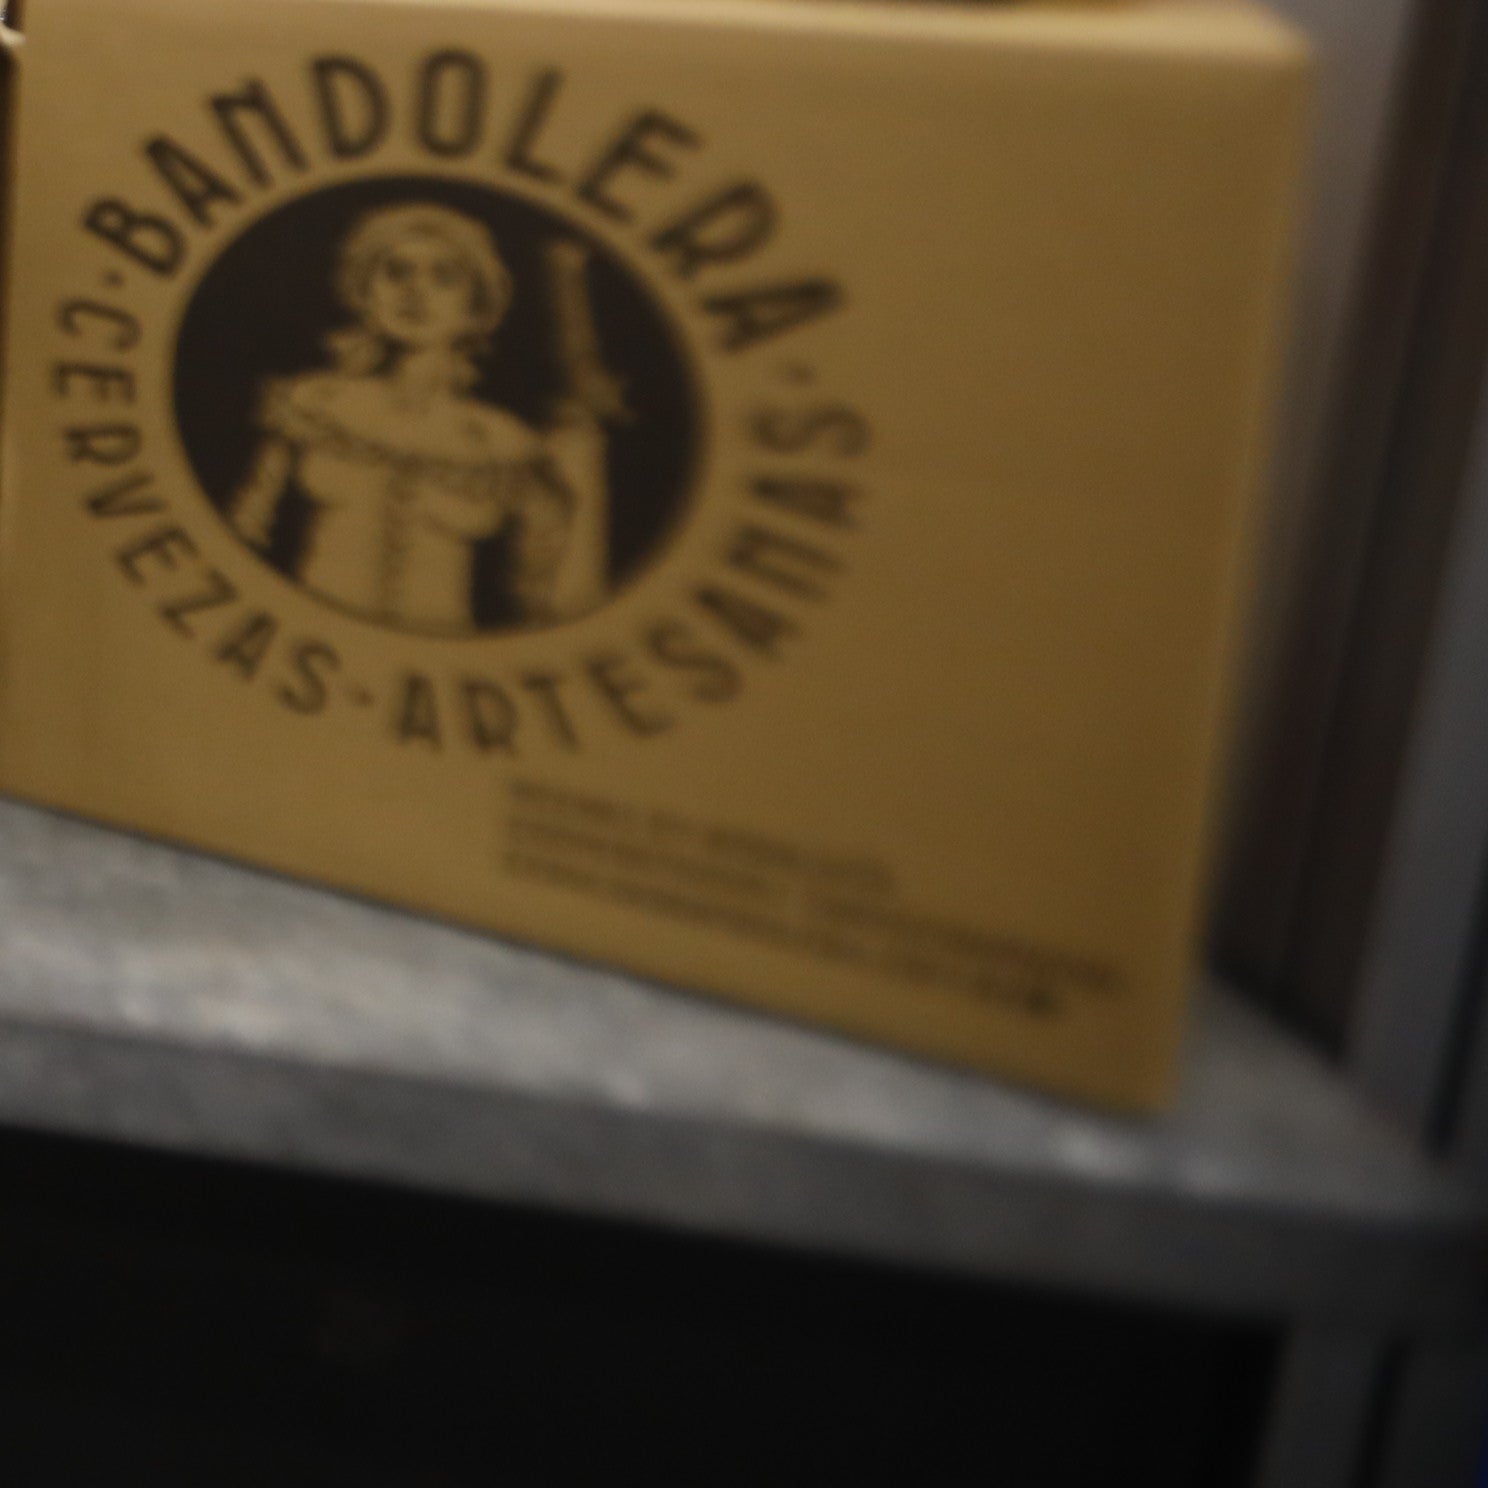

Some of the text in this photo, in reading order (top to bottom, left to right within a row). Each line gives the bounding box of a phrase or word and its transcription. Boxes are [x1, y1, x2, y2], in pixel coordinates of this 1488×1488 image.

[81, 47, 842, 355] BANDOLERA
[51, 296, 871, 756] CERVEZAS ARTESANAS
